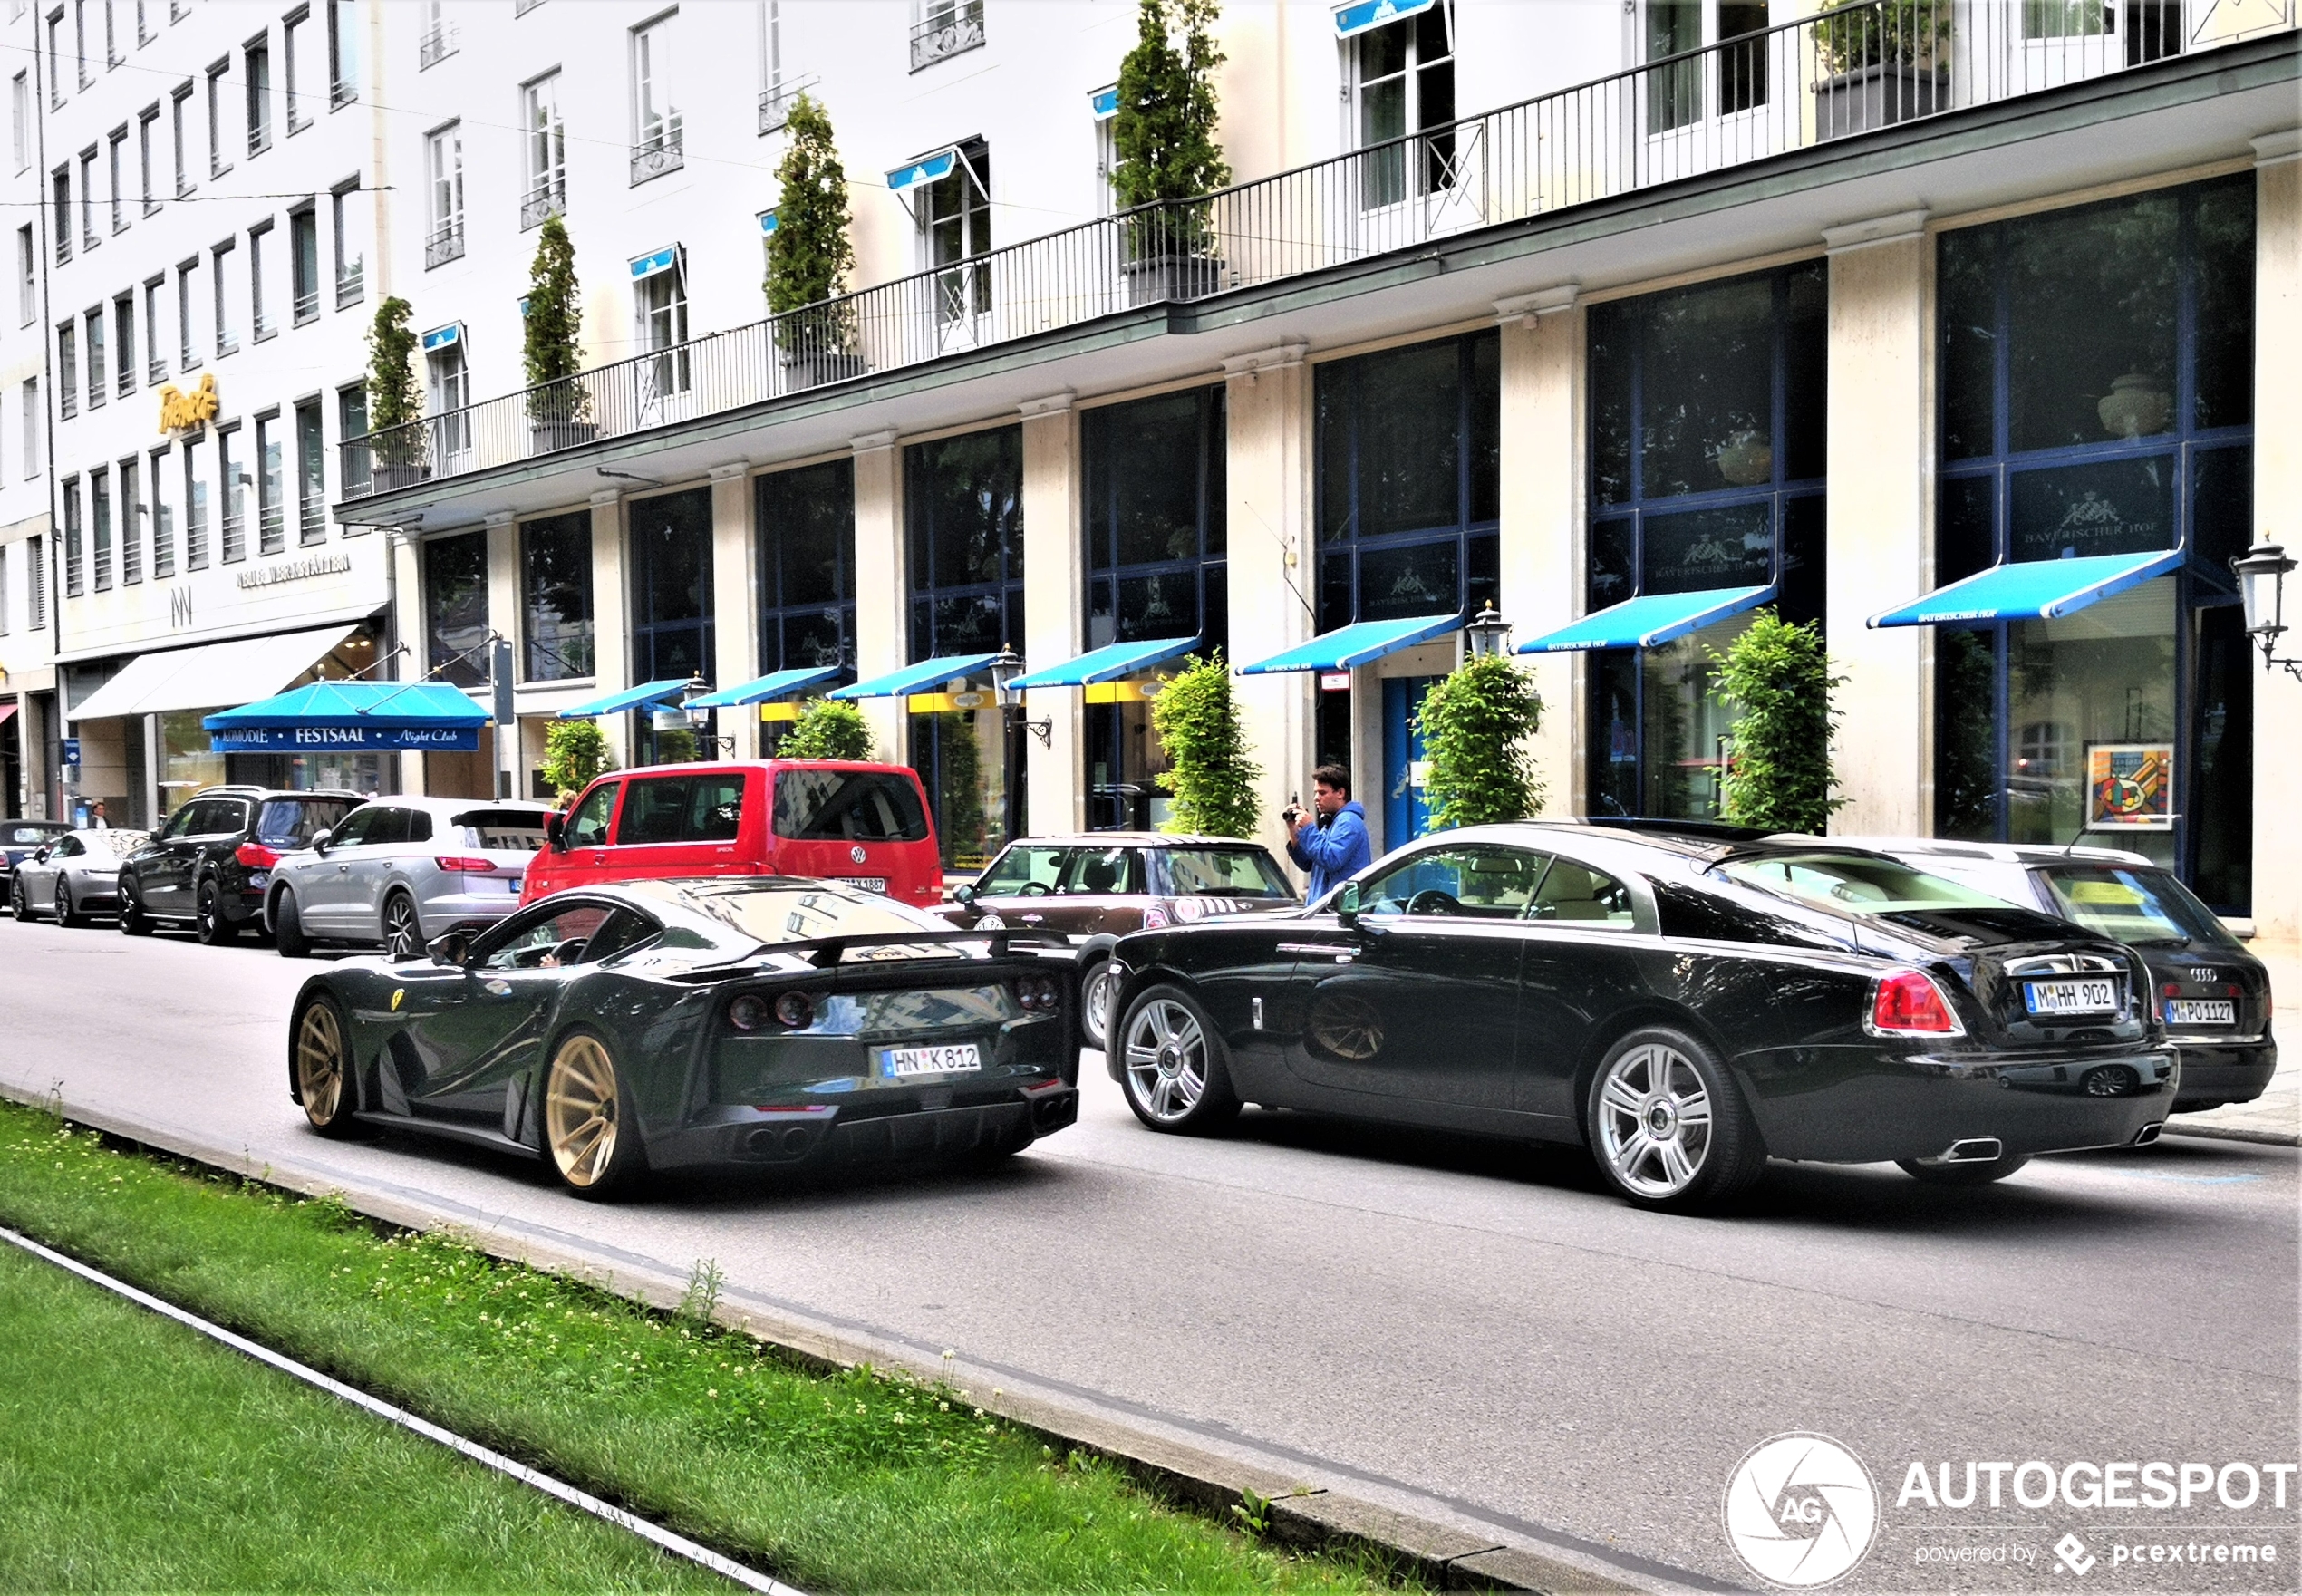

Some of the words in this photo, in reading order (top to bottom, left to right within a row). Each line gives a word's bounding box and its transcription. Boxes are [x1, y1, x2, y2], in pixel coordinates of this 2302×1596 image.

[2025, 525, 2122, 544] BAYERISCHER
[2130, 522, 2158, 534] HOF
[1655, 564, 1731, 579] BAYERISCHER
[1918, 610, 1978, 622] BAYERISCHER
[1978, 608, 1998, 618] HOF
[223, 726, 268, 744] KOMÖDIE
[295, 727, 365, 743] FESTSAAL
[393, 729, 430, 744] Night
[431, 728, 457, 742] Club
[864, 879, 884, 890] 1887
[2036, 986, 2049, 1008] M
[2055, 984, 2078, 1007] HH
[2082, 983, 2111, 1005] 902
[2171, 1002, 2181, 1020] M
[2187, 1002, 2202, 1020] PO
[2204, 1002, 2231, 1020] 1127
[894, 1051, 920, 1073] HN
